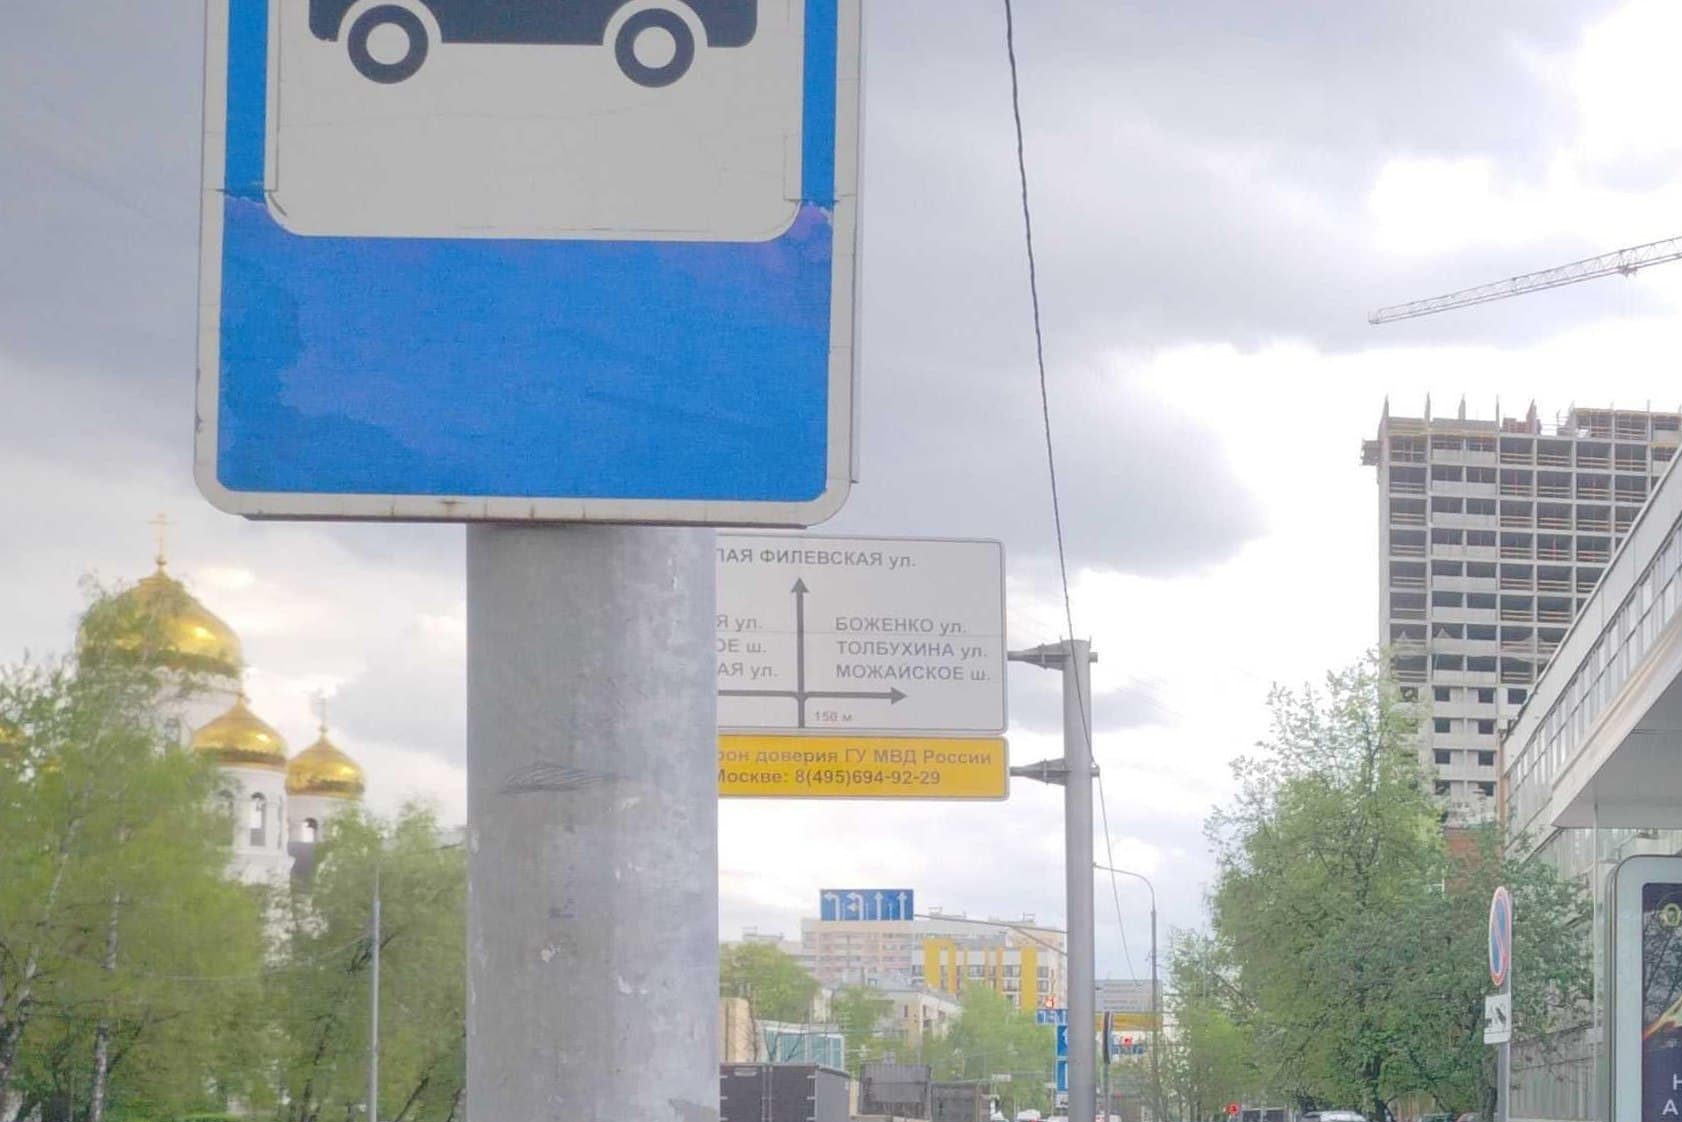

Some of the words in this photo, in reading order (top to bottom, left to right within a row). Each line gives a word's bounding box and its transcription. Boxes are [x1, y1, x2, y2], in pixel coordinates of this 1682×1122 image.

[760, 549, 883, 566] ФИЛЕВСКАЯ
[888, 555, 916, 570] ул.
[835, 616, 934, 633] БОЖЕНКО
[940, 621, 967, 635] ул.
[837, 640, 955, 658] ТОЛБУХИНА
[960, 646, 987, 661] ул.
[750, 666, 779, 681] ул.
[836, 662, 965, 681] МОЖАЙСКОЕ
[755, 751, 838, 766] доверия
[845, 750, 867, 763] ГУ
[873, 750, 917, 766] МВД
[923, 750, 992, 765] России
[795, 770, 941, 787] 8(495)694-92-29
[1662, 1099, 1679, 1116] А
